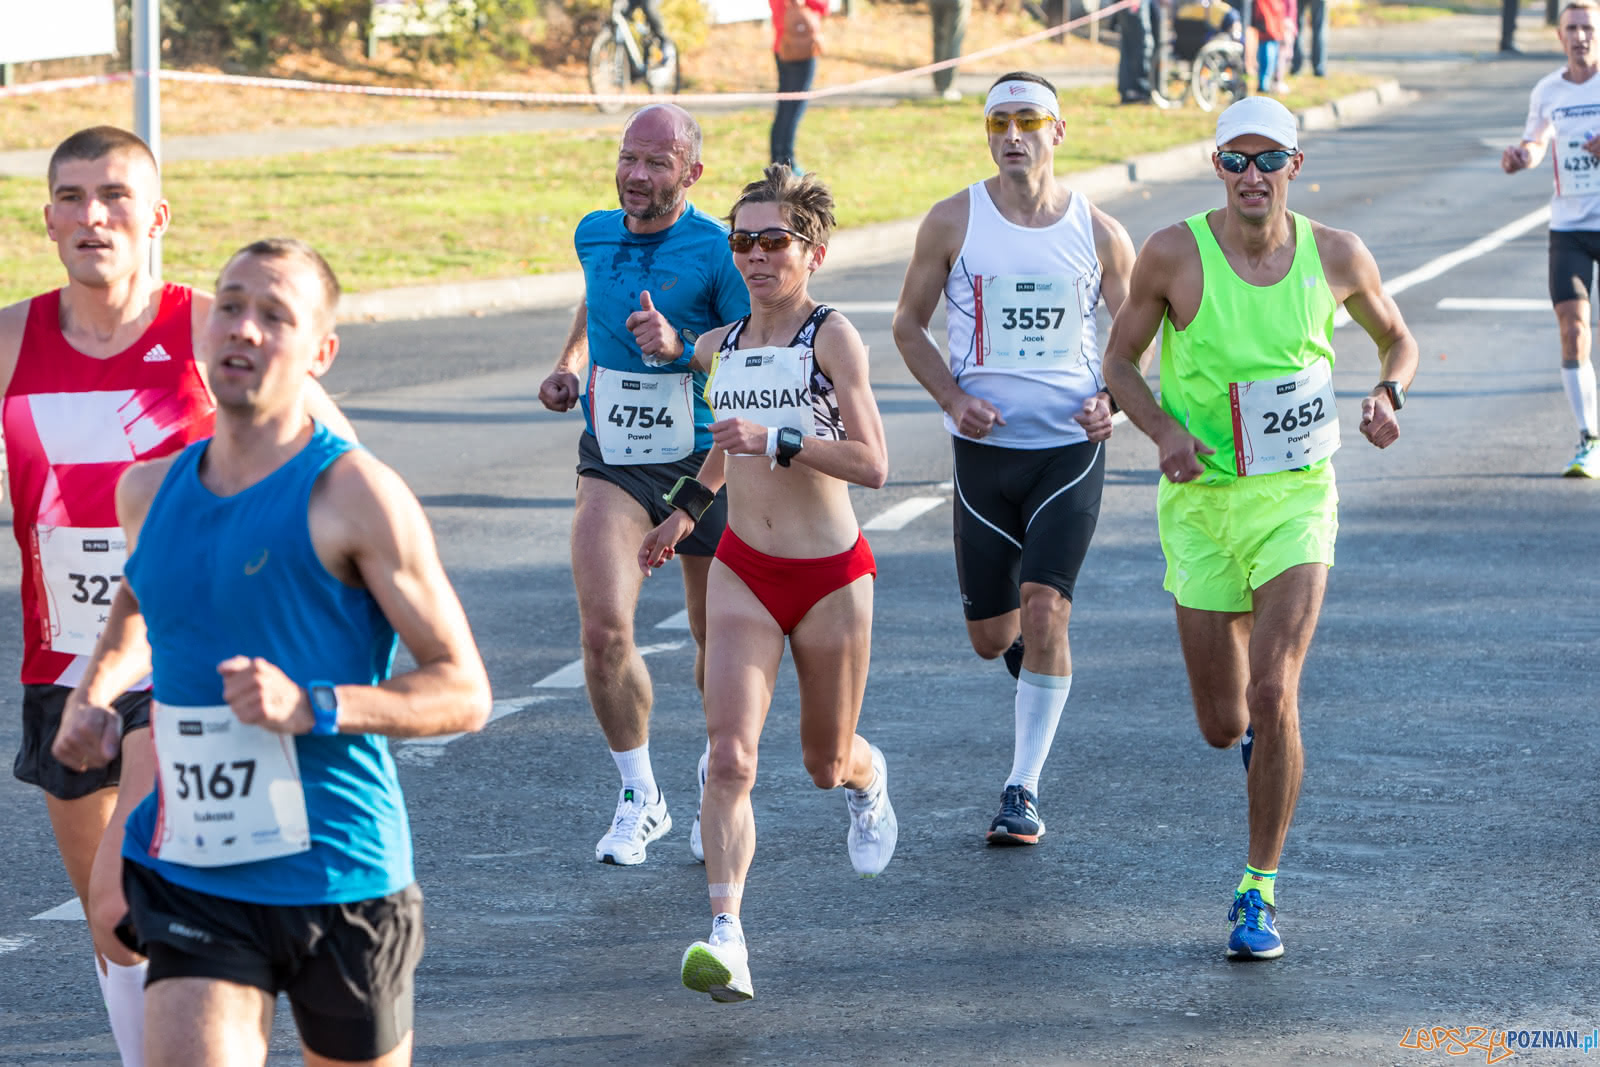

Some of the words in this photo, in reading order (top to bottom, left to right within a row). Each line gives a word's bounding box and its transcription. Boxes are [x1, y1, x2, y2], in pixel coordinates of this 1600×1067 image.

[1002, 307, 1065, 330] 3557
[713, 388, 811, 410] JANASIAK
[608, 404, 674, 428] 4754
[1262, 397, 1325, 434] 2652
[173, 760, 256, 800] 3167
